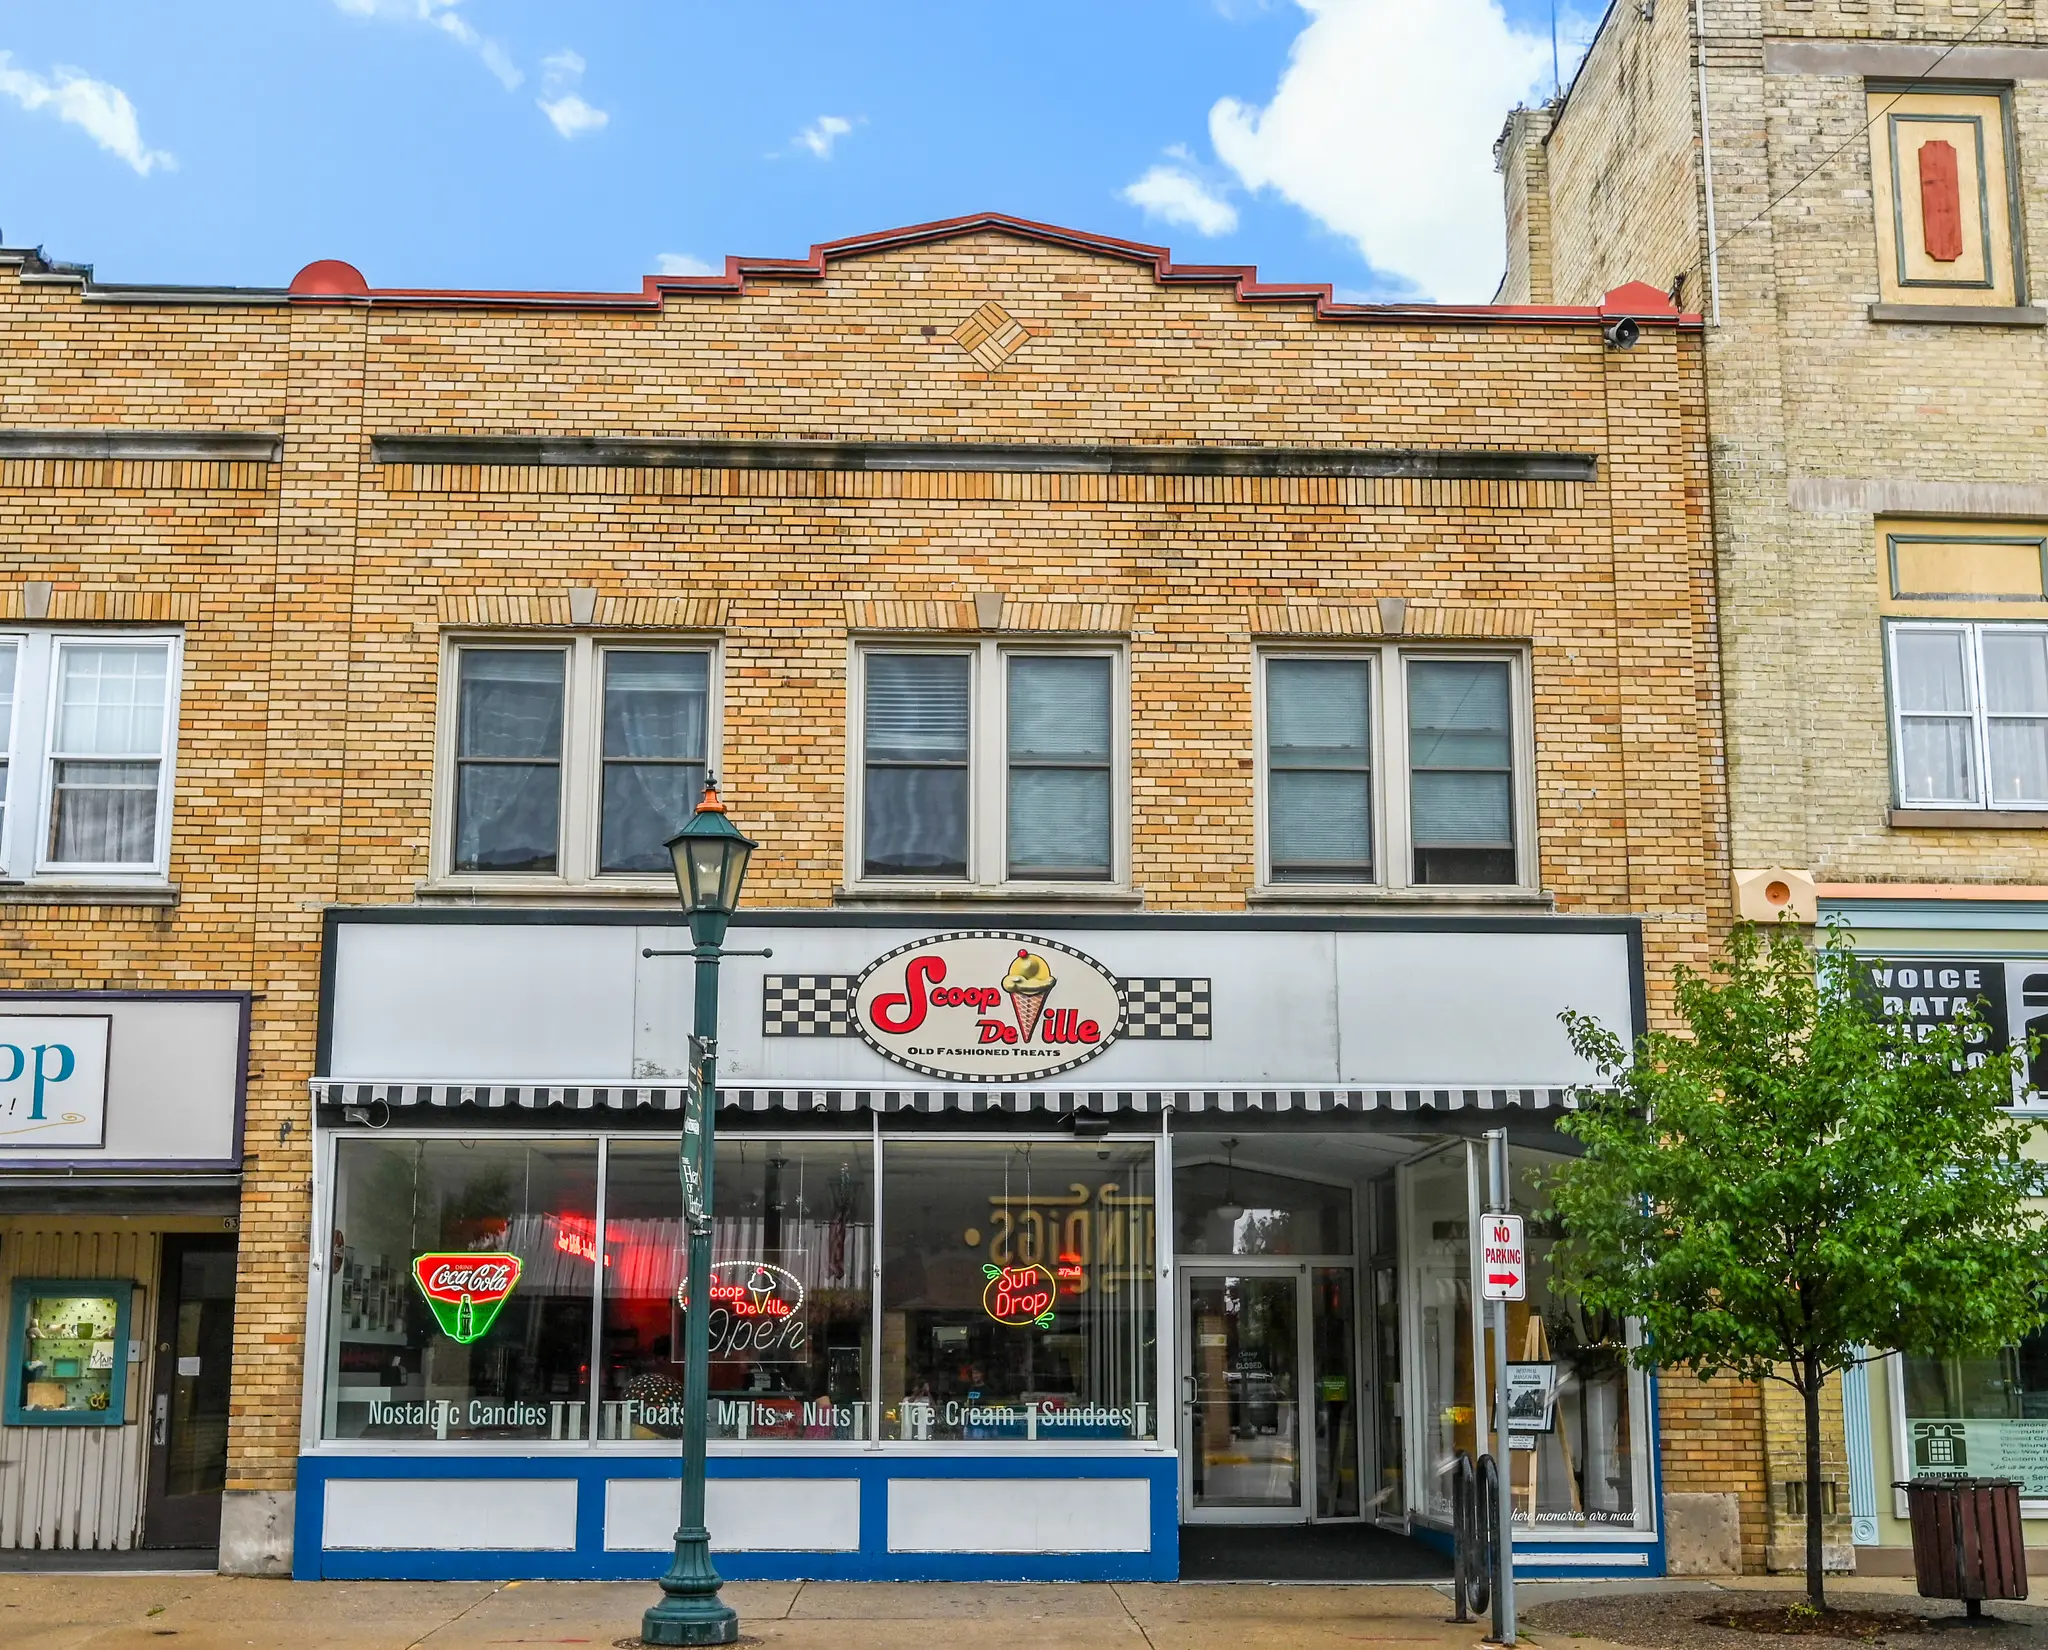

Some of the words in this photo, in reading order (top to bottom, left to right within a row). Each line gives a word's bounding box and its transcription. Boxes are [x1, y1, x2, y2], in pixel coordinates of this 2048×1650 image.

[1871, 968, 1982, 989] VOICE
[869, 955, 1002, 1035] Scoop
[1882, 996, 1971, 1016] DATA
[907, 1047, 935, 1056] OLD
[937, 1047, 1010, 1057] FASHIONED
[1012, 1048, 1062, 1057] TREATS
[1493, 1226, 1510, 1243] NO
[1485, 1247, 1521, 1265] PARKING
[998, 1266, 1037, 1292] Sun
[996, 1292, 1048, 1316] Drop
[708, 1308, 805, 1359] Open
[1236, 1361, 1263, 1370] CLOSED
[368, 1400, 460, 1430] Nostalgc
[469, 1400, 547, 1426] Candies
[803, 1401, 851, 1427] Nuts
[946, 1400, 1014, 1426] Cream
[1041, 1401, 1132, 1427] Sundaes
[1510, 1507, 1532, 1521] here
[1535, 1510, 1586, 1521] memories
[1589, 1512, 1608, 1521] are
[1609, 1507, 1640, 1521] made
